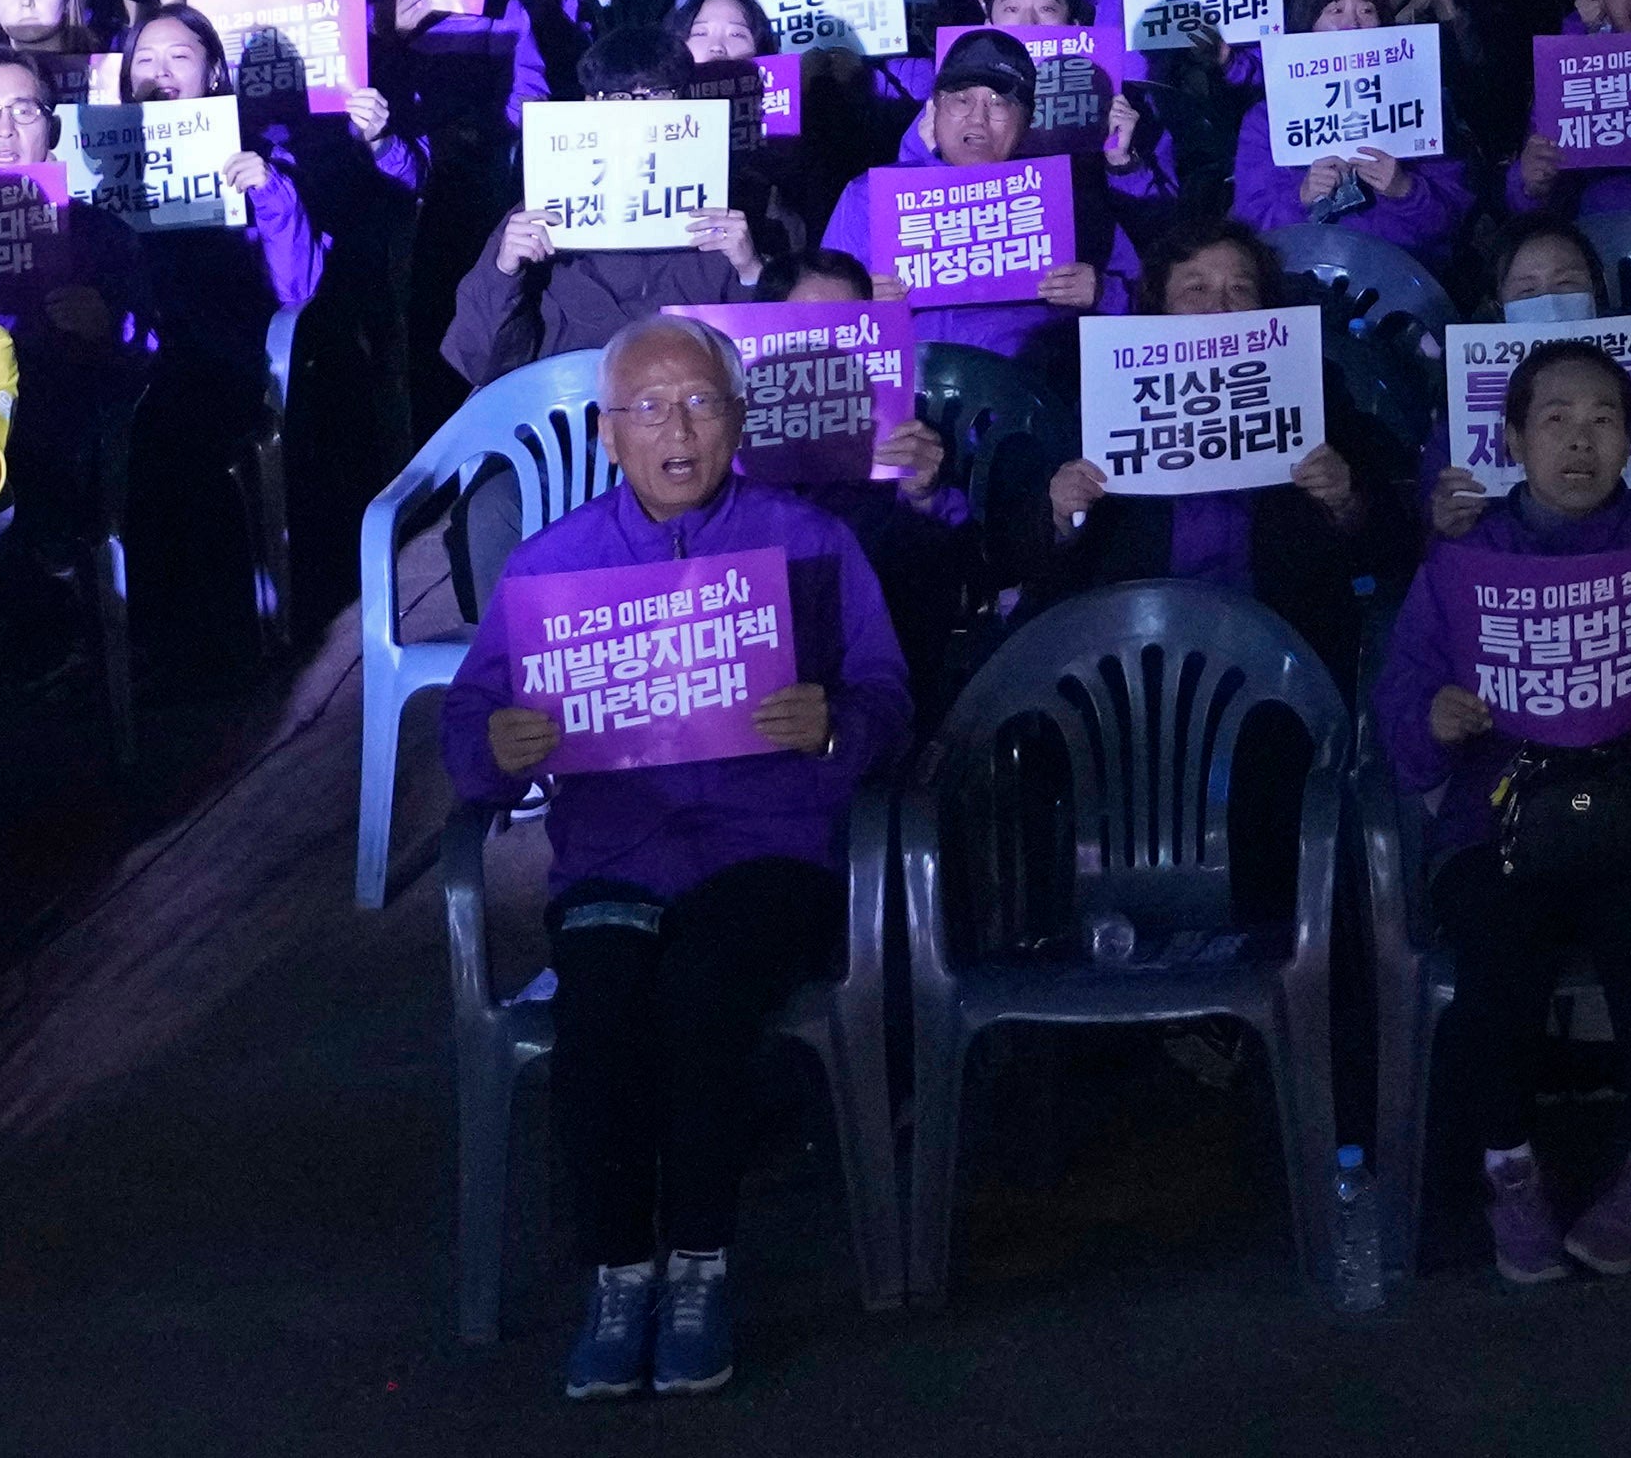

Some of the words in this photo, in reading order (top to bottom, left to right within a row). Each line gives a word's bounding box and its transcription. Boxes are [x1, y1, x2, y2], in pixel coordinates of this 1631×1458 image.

[1286, 60, 1328, 80] 10.29
[1333, 51, 1380, 75] 이태원
[1558, 54, 1603, 75] 10.29
[1324, 79, 1382, 111] 기억
[1284, 105, 1425, 150] 하겠습니다
[112, 150, 173, 175] 기억
[895, 189, 943, 210] 10.29
[948, 178, 1001, 203] 이태원
[897, 198, 1046, 244] 특별법을
[762, 329, 829, 358] 이태원
[1112, 343, 1168, 371] 10.29
[1174, 333, 1240, 364] 이태원
[1462, 339, 1524, 366] 10.29
[1131, 358, 1273, 419] 진상을
[1474, 583, 1536, 611] 10.29
[1541, 576, 1617, 610] 이태원
[542, 606, 613, 644] 10.29
[620, 589, 694, 627] 이태원
[521, 601, 779, 698] 재발방지대책
[561, 660, 749, 736] 마련하라!
